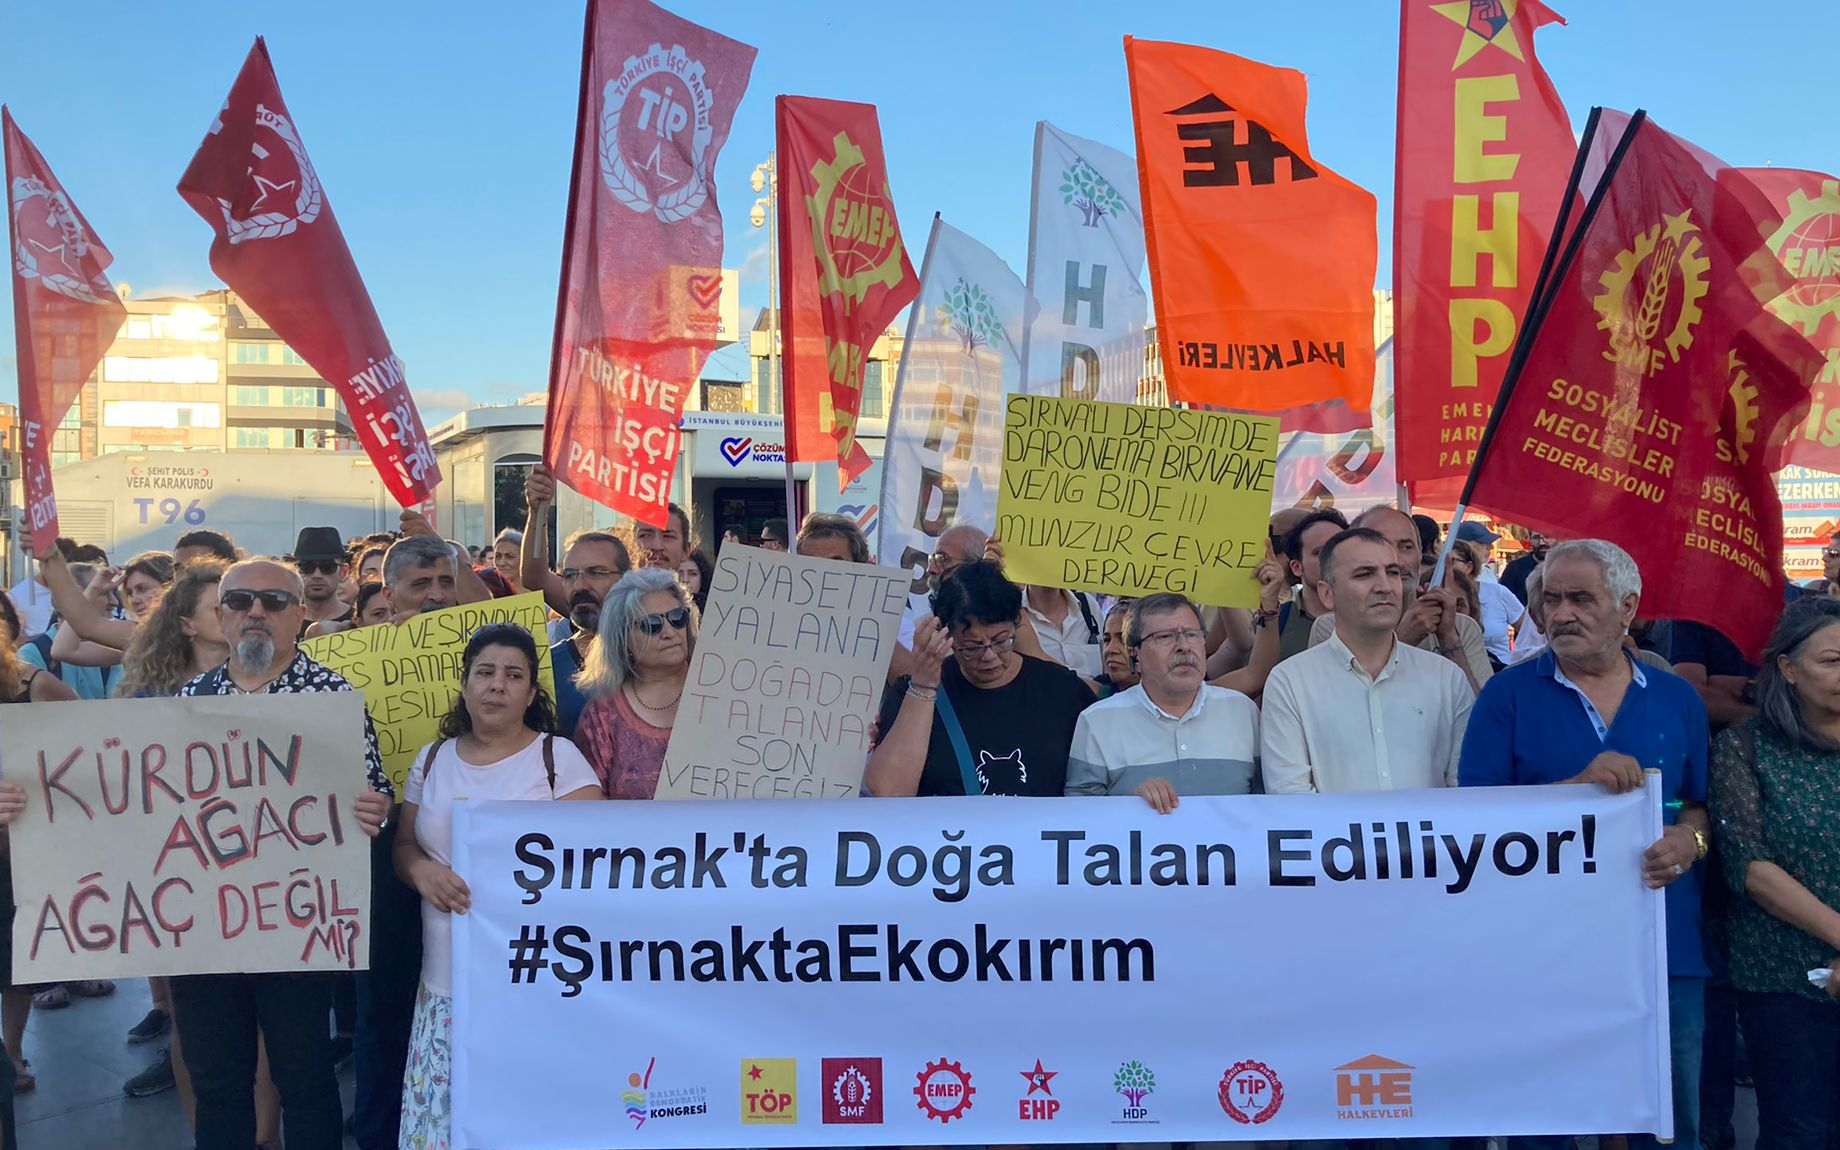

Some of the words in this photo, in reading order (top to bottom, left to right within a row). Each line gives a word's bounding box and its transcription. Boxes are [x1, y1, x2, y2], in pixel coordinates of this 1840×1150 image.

[637, 86, 688, 142] TİP
[1449, 73, 1521, 387] EHP
[1060, 260, 1107, 400] HD
[578, 345, 680, 415] TÜRKİYE
[613, 407, 677, 465] İŞÇİ
[734, 418, 784, 428] BÜYÜKŞEHİ
[1546, 378, 1682, 446] SOSYALİST
[127, 477, 151, 489] VEFA
[153, 477, 213, 490] KARAKURDU
[172, 468, 195, 476] POLİS
[567, 441, 670, 507] PARTİSİ
[1005, 469, 1087, 504] VENG
[1097, 473, 1172, 522] BİDE
[1521, 437, 1666, 504] FEDERASYONU
[133, 498, 206, 526] T96
[1000, 514, 1133, 555] MUNZUR
[1144, 532, 1257, 569] ÇEVRE
[713, 556, 907, 616] SİYASETTE
[714, 600, 880, 662] YALANA
[698, 652, 873, 712] DOĞADA
[37, 729, 302, 823] KÜRDÜN
[731, 735, 817, 775] SON
[153, 794, 345, 876] AĞACI
[513, 831, 808, 905] Şırnak'ta
[834, 829, 1015, 903] Doğa
[1041, 830, 1236, 886] Talan
[1267, 814, 1597, 894] Ediliyor!
[29, 872, 194, 961] AĞAÇ
[508, 923, 1155, 998] #ŞırnaktaEkokırım
[650, 1101, 707, 1119] KONGRESİ
[746, 1089, 792, 1113] TÖP
[839, 1106, 865, 1117] SMF
[927, 1083, 962, 1098] EMEP
[1019, 1099, 1061, 1120] EHP
[1236, 1075, 1266, 1095] TİP
[1337, 1106, 1414, 1120] HALKEVLERİ
[1123, 1108, 1148, 1119] HDP
